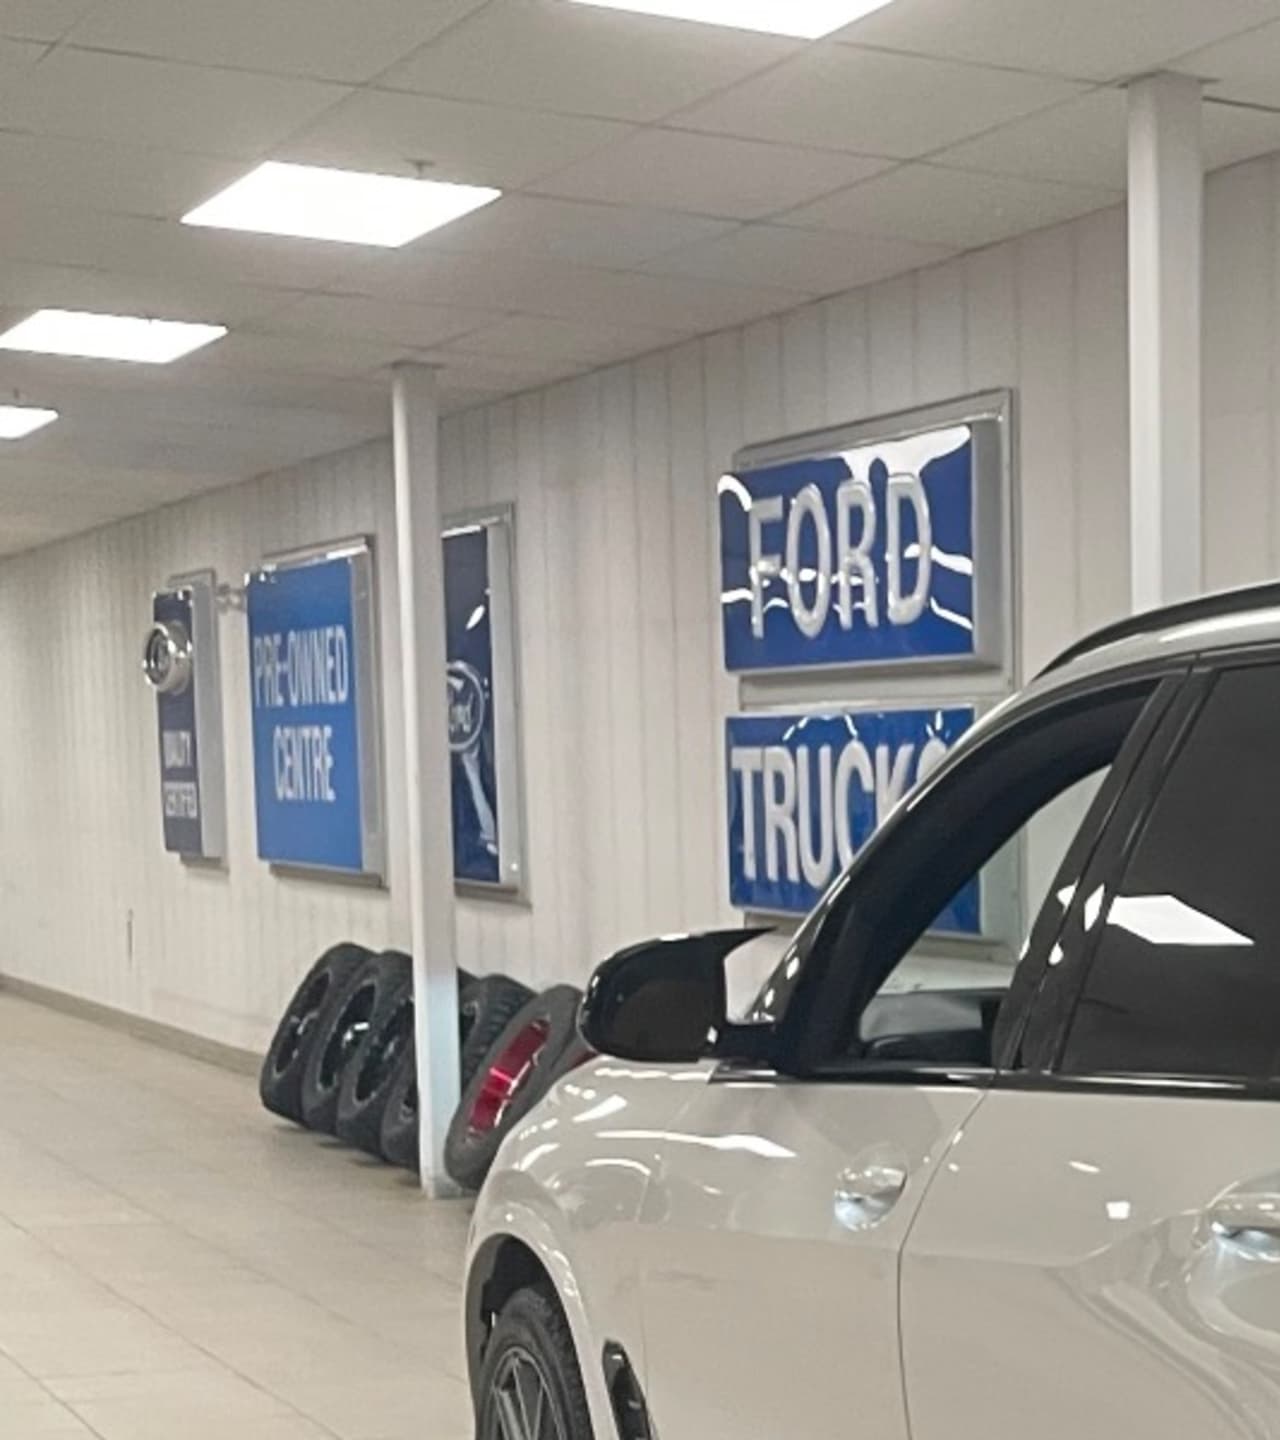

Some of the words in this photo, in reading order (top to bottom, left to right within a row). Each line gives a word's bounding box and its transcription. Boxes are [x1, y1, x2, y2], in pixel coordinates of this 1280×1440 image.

[750, 472, 932, 640] FORD
[253, 625, 349, 707] PRE-OWNED
[273, 724, 336, 802] CENTRE
